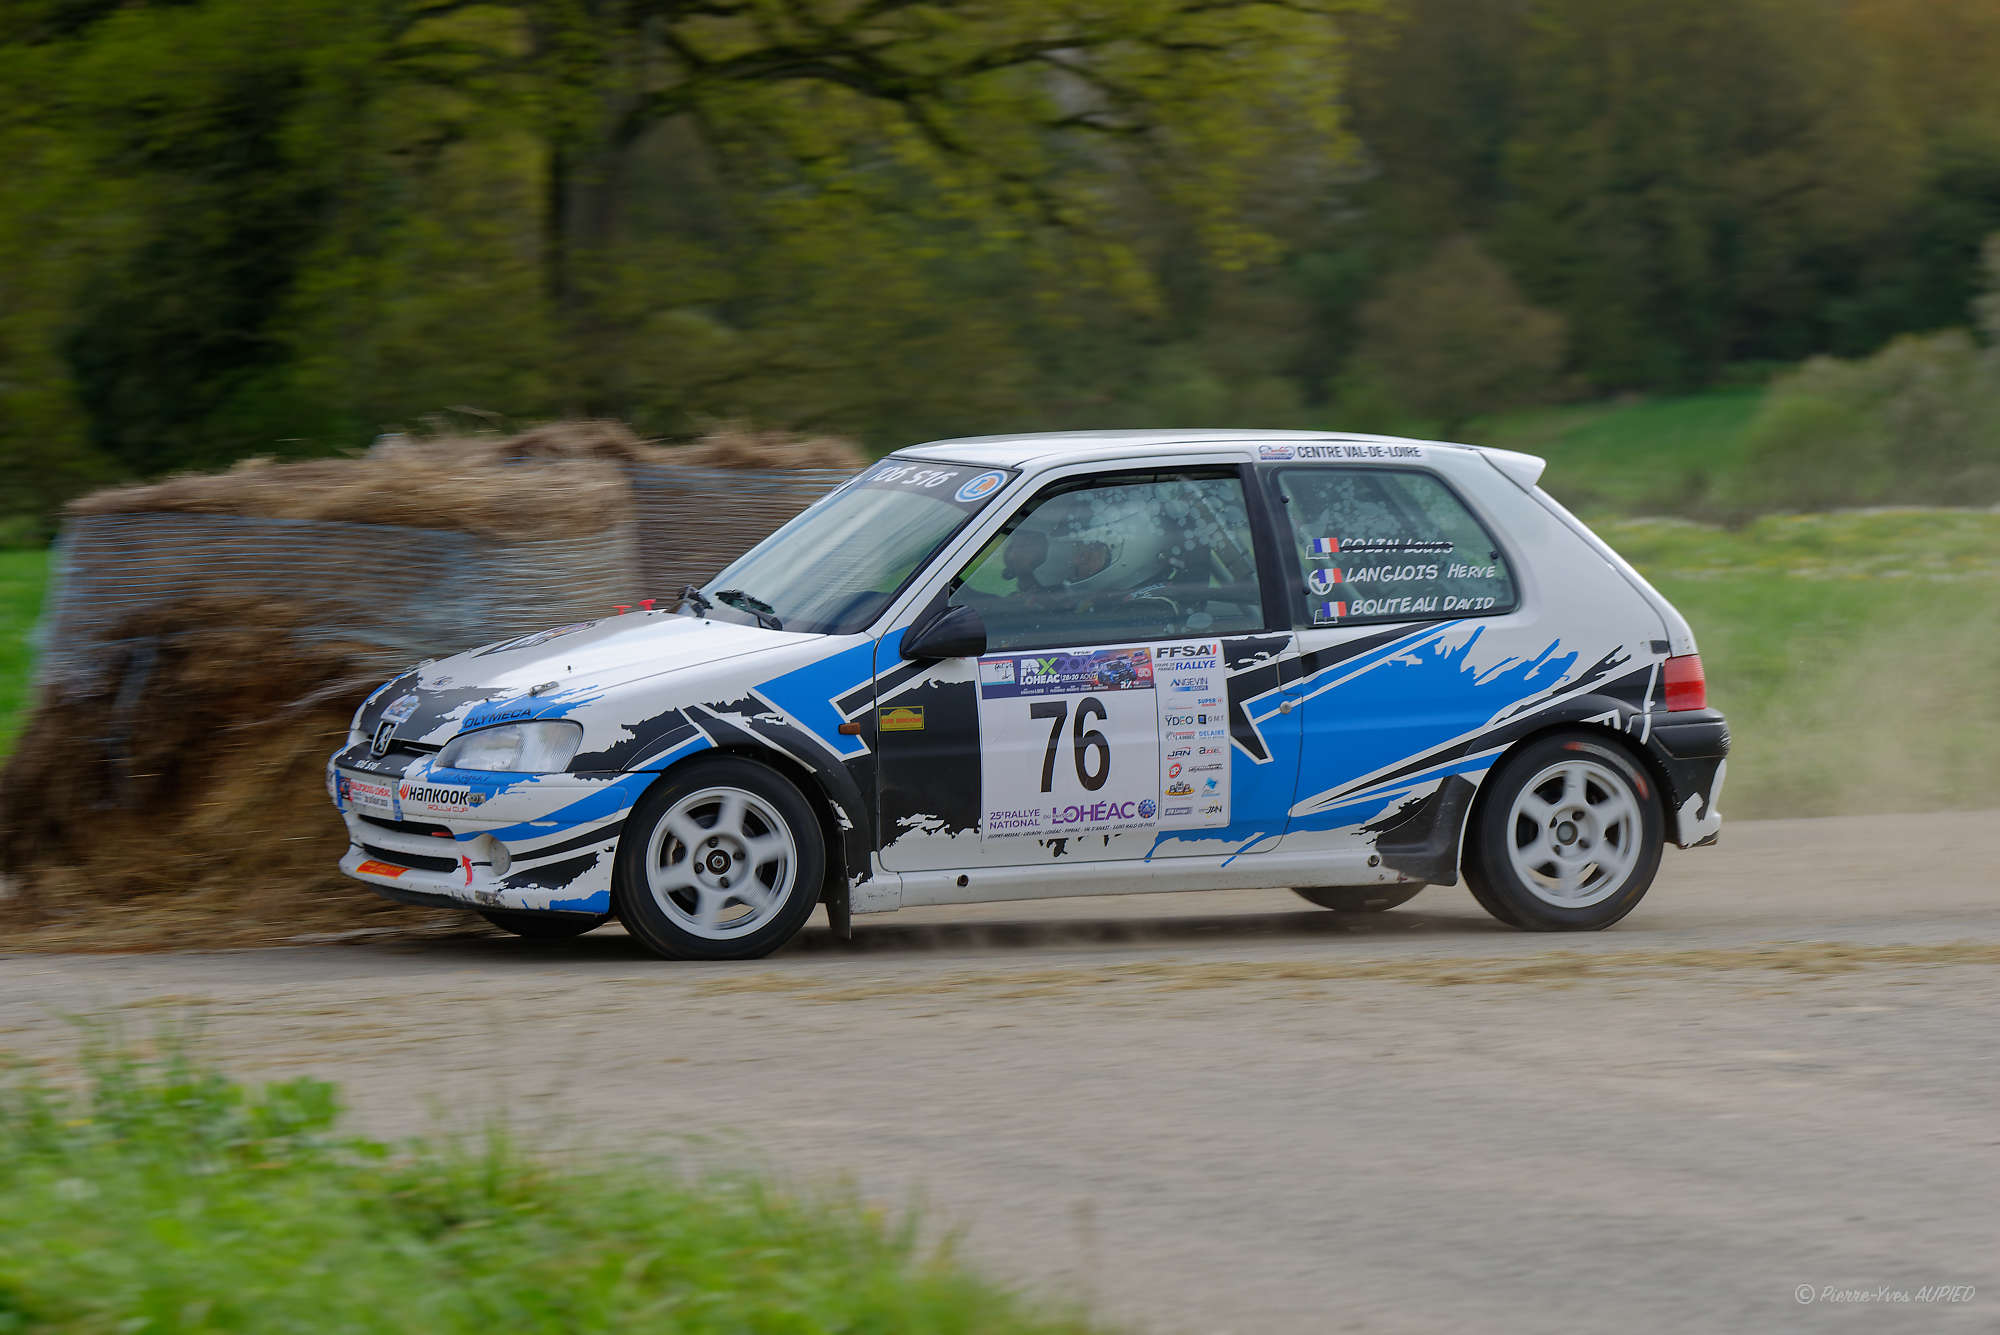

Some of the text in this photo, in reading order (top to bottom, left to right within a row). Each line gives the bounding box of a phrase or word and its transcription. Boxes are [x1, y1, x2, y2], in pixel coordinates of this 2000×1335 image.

[1297, 446, 1342, 458] CENTRE
[1343, 446, 1422, 458] VAL-DE-LOIRE
[901, 470, 959, 488] S16
[1341, 538, 1399, 553] COLIN
[1345, 563, 1496, 582] LANGLOIS HERVE
[1350, 595, 1496, 615] BOUTEAU DAVID
[1157, 644, 1211, 658] FFSA
[1020, 657, 1058, 676] RX
[1176, 660, 1217, 670] RALLYE
[1019, 674, 1061, 686] LOHEAC
[1030, 697, 1110, 792] 76
[1004, 809, 1040, 819] RALLYE
[1052, 801, 1135, 824] LOHÉAC
[990, 819, 1040, 830] NATIONAL
